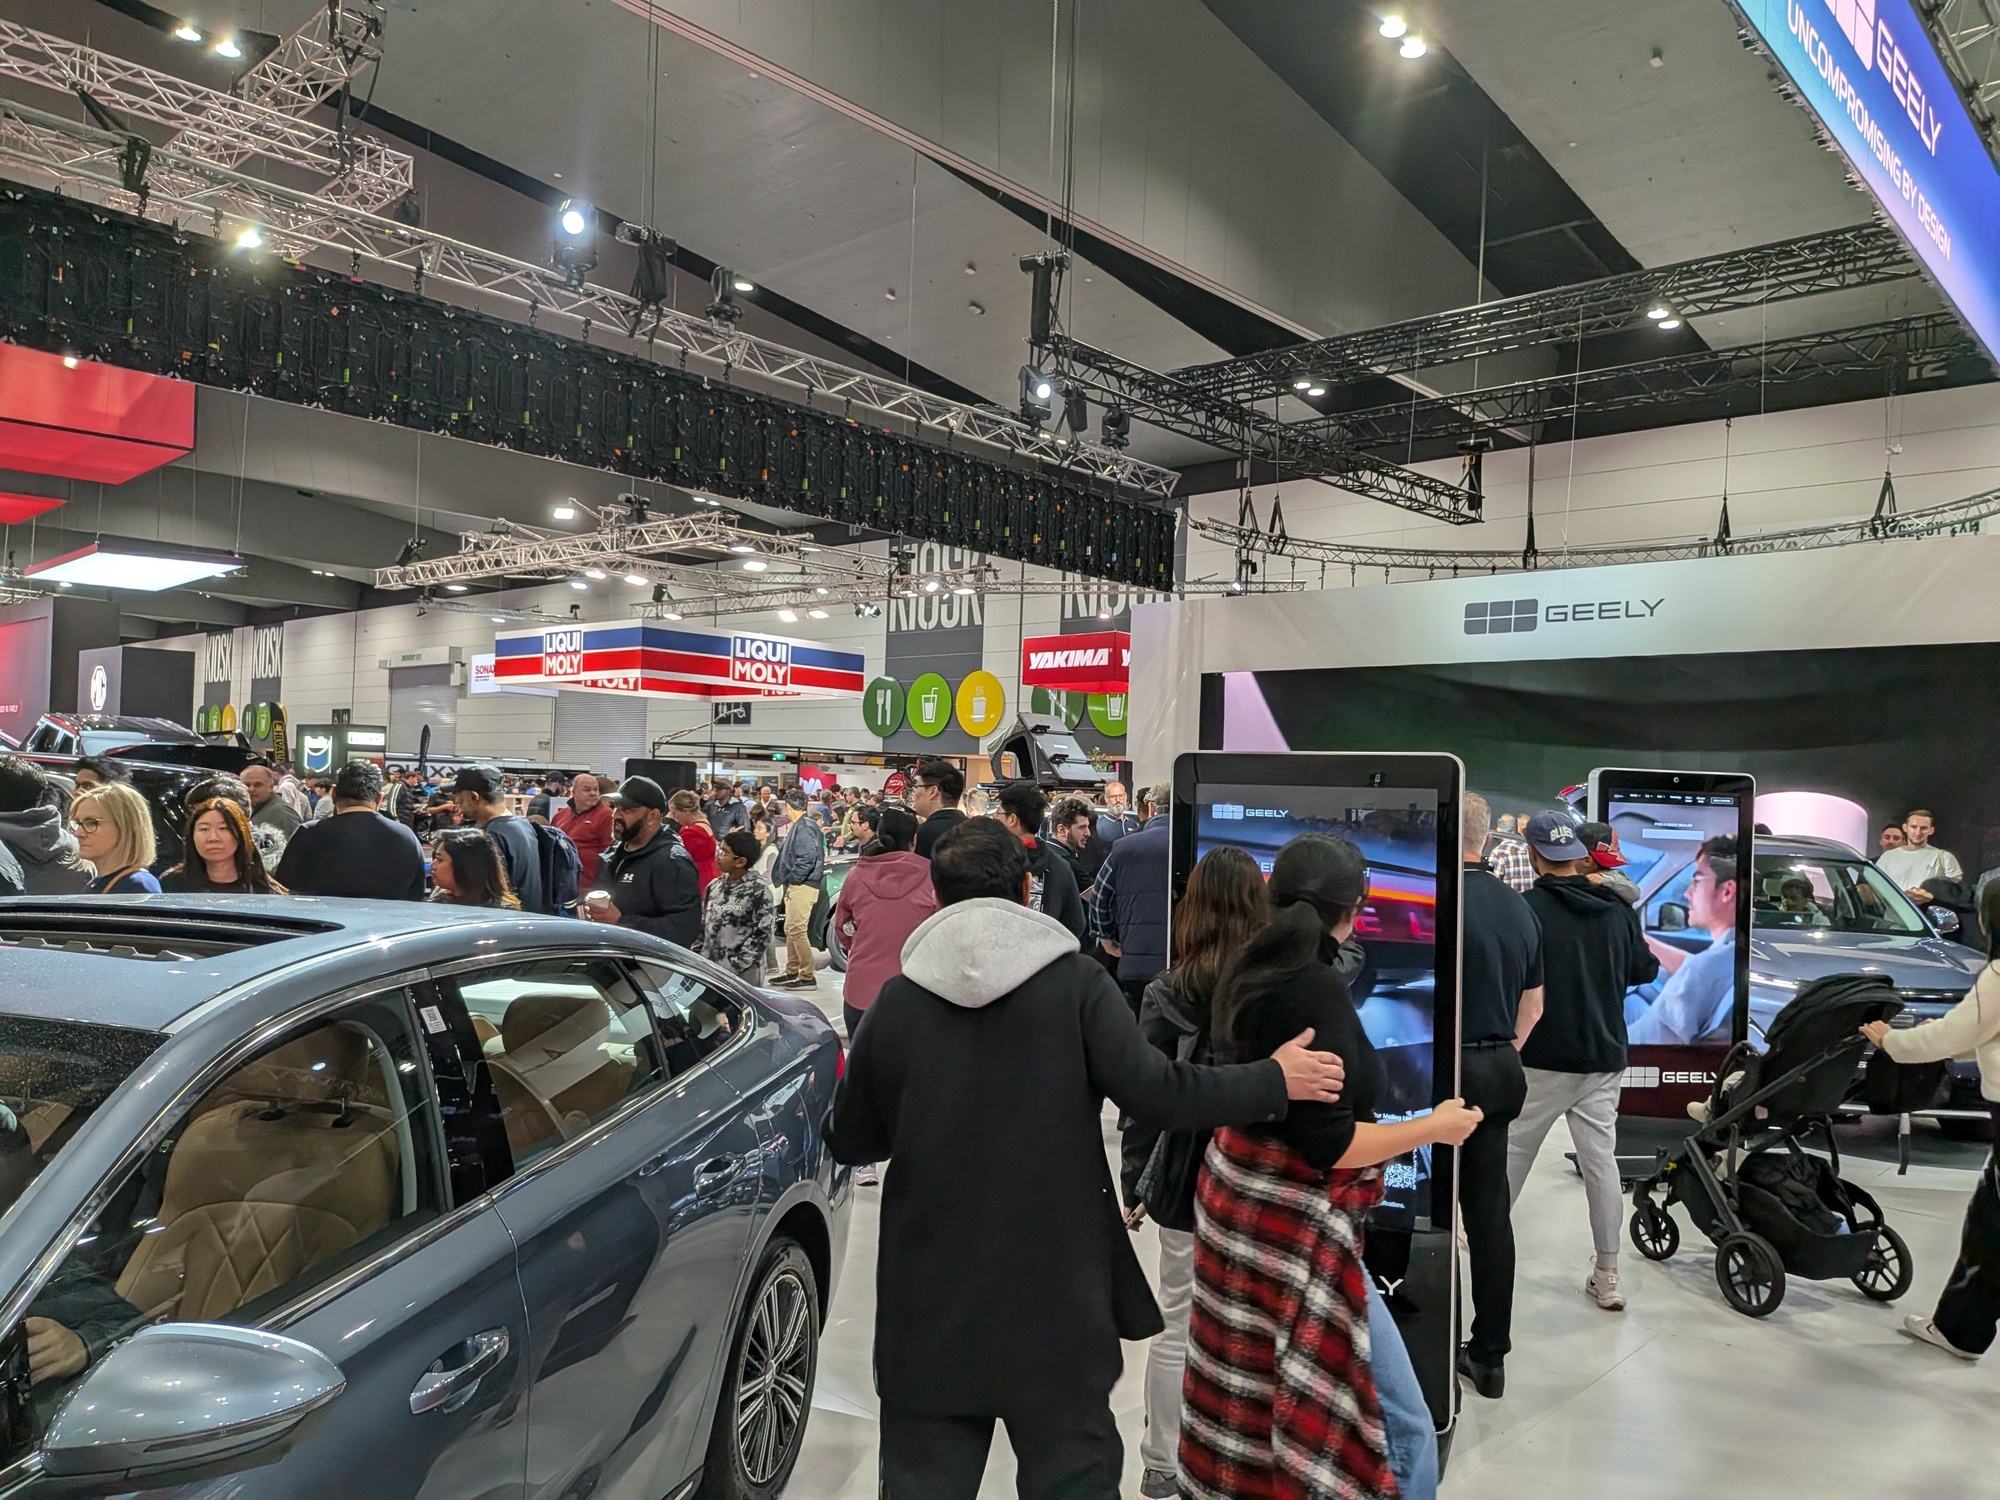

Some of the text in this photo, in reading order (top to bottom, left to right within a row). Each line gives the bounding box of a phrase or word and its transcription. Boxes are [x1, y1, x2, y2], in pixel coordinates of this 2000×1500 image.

[1877, 19, 1942, 157] GEELY
[1787, 0, 1950, 261] UNCOMPROMISING BY DESIGN
[1545, 598, 1666, 623] GEELY
[252, 627, 283, 679] KIOSK
[546, 632, 580, 653] LIQUI
[735, 638, 787, 662] LIQUI
[205, 633, 232, 683] KIOSK
[546, 654, 580, 675] MOLY
[1029, 648, 1109, 670] YAKIMA
[734, 661, 788, 684] MOLY
[1245, 808, 1289, 818] GEELY
[1550, 825, 1574, 842] BLUES
